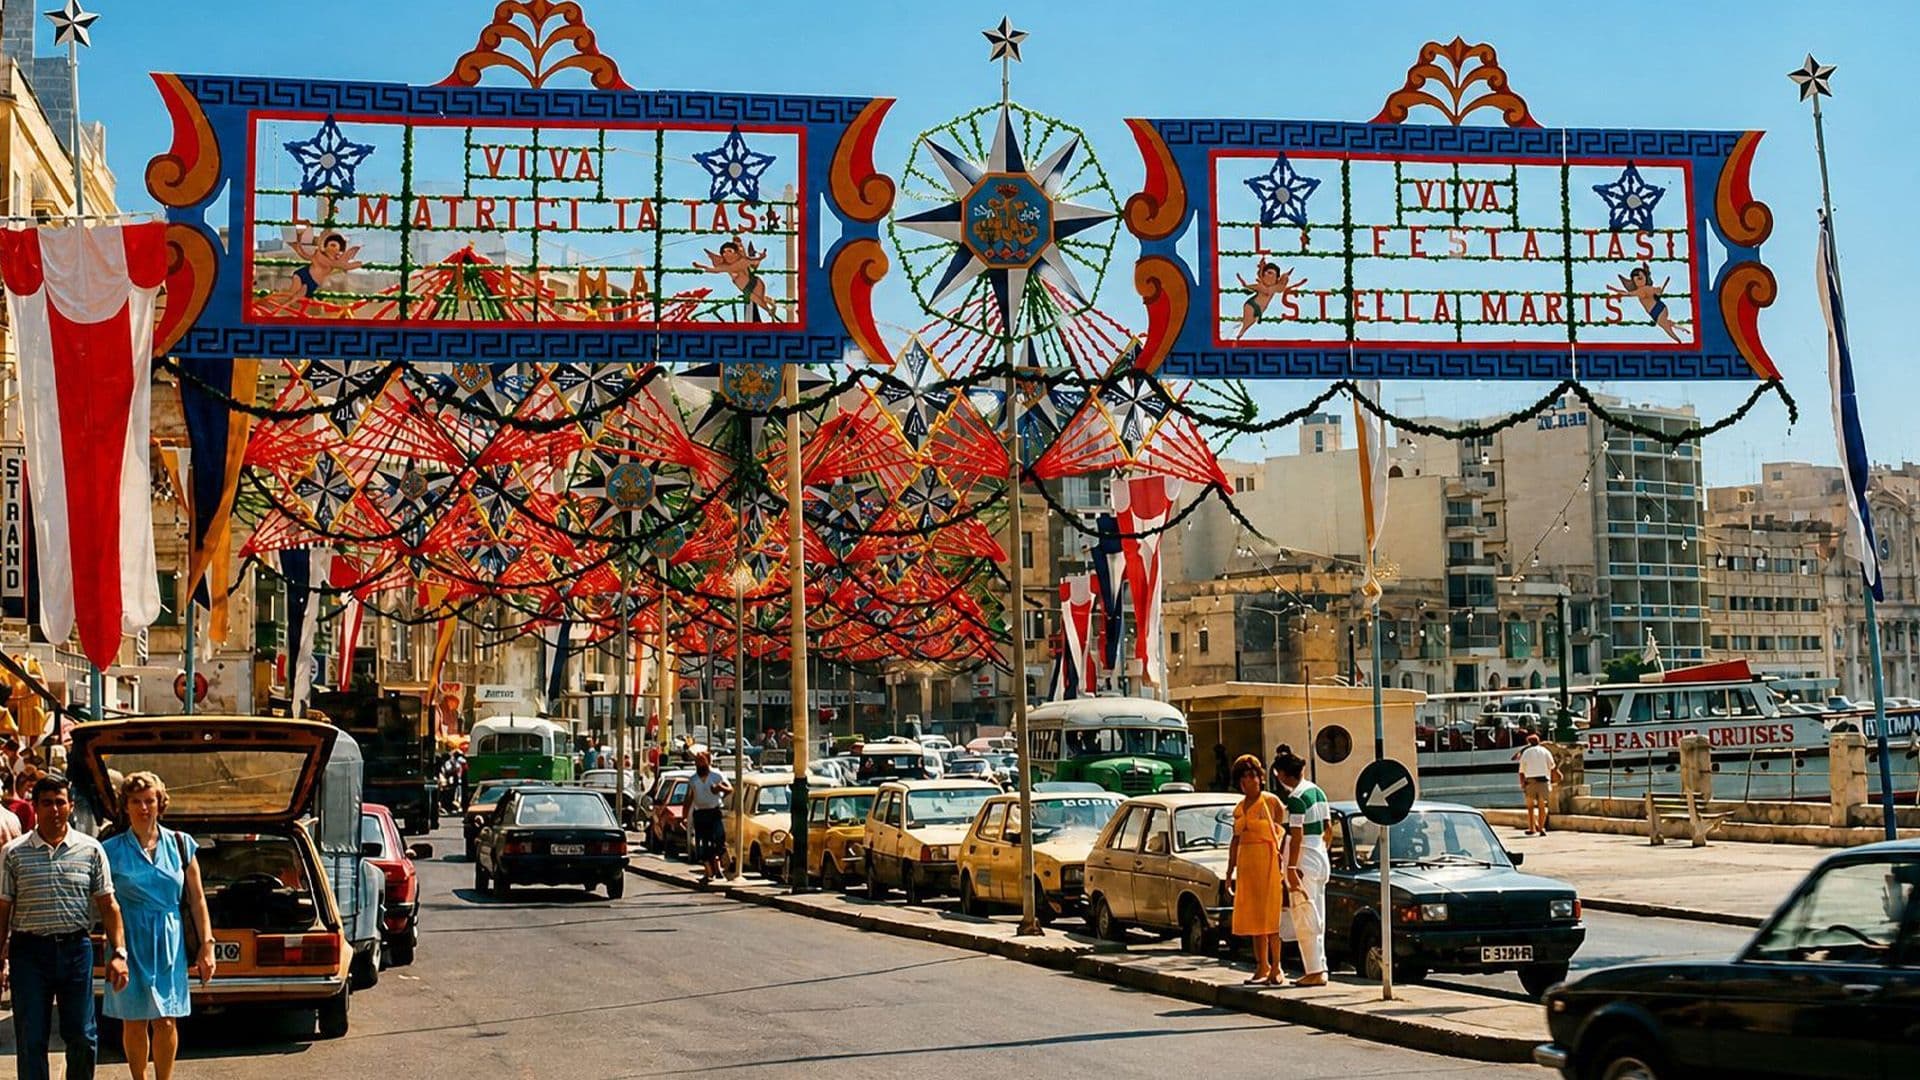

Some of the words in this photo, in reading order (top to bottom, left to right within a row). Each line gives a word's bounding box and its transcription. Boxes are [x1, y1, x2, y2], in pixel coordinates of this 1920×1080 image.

[483, 146, 597, 180] VIVA
[357, 193, 578, 230] MATRICI
[1416, 181, 1499, 210] VIVA
[1372, 226, 1541, 260] FESTA
[1281, 289, 1451, 322] STELLA
[1481, 291, 1623, 324] MARIS
[6, 458, 19, 589] STRAND
[1709, 724, 1794, 746] CRUISES
